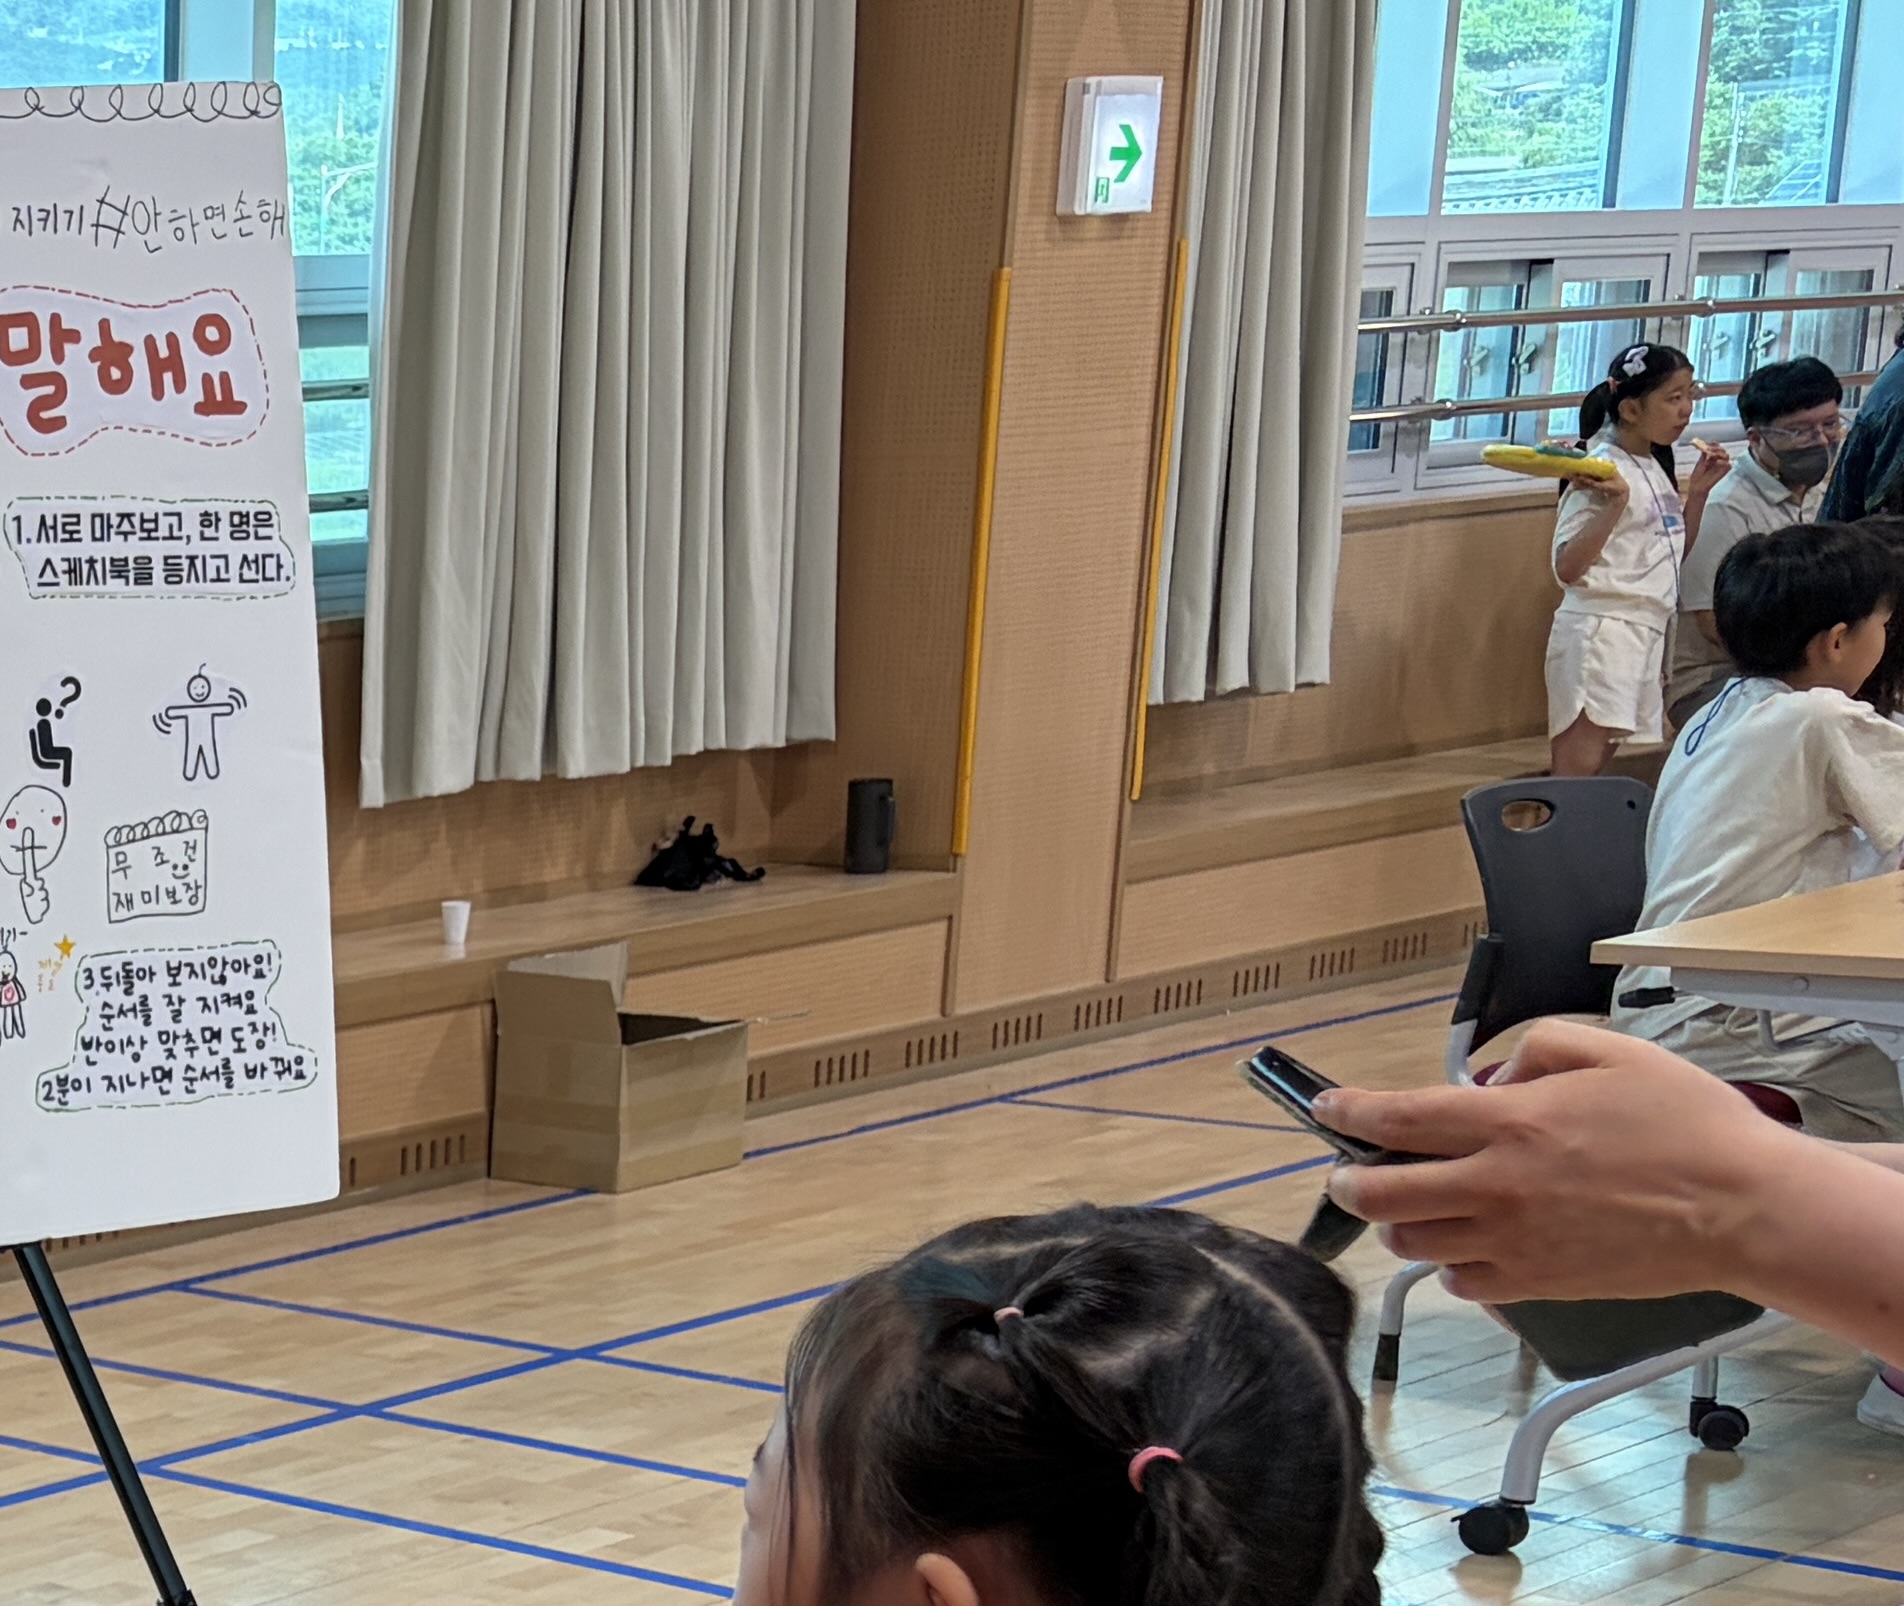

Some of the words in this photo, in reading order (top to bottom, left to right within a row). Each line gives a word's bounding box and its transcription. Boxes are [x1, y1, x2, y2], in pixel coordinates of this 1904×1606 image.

[12, 203, 85, 237] 지키기
[91, 511, 192, 546] 마주보고,
[198, 510, 222, 542] 한
[228, 510, 275, 542] 명은
[37, 555, 154, 587] 스케치북을
[162, 554, 231, 585] 등지고
[238, 552, 291, 584] 선다.
[99, 993, 153, 1032] 순서를
[161, 993, 187, 1024] 잘
[195, 989, 258, 1016] 지켜요
[80, 1034, 148, 1067] 반이상
[100, 1065, 174, 1096] 지나면
[182, 1056, 235, 1095] 순서를
